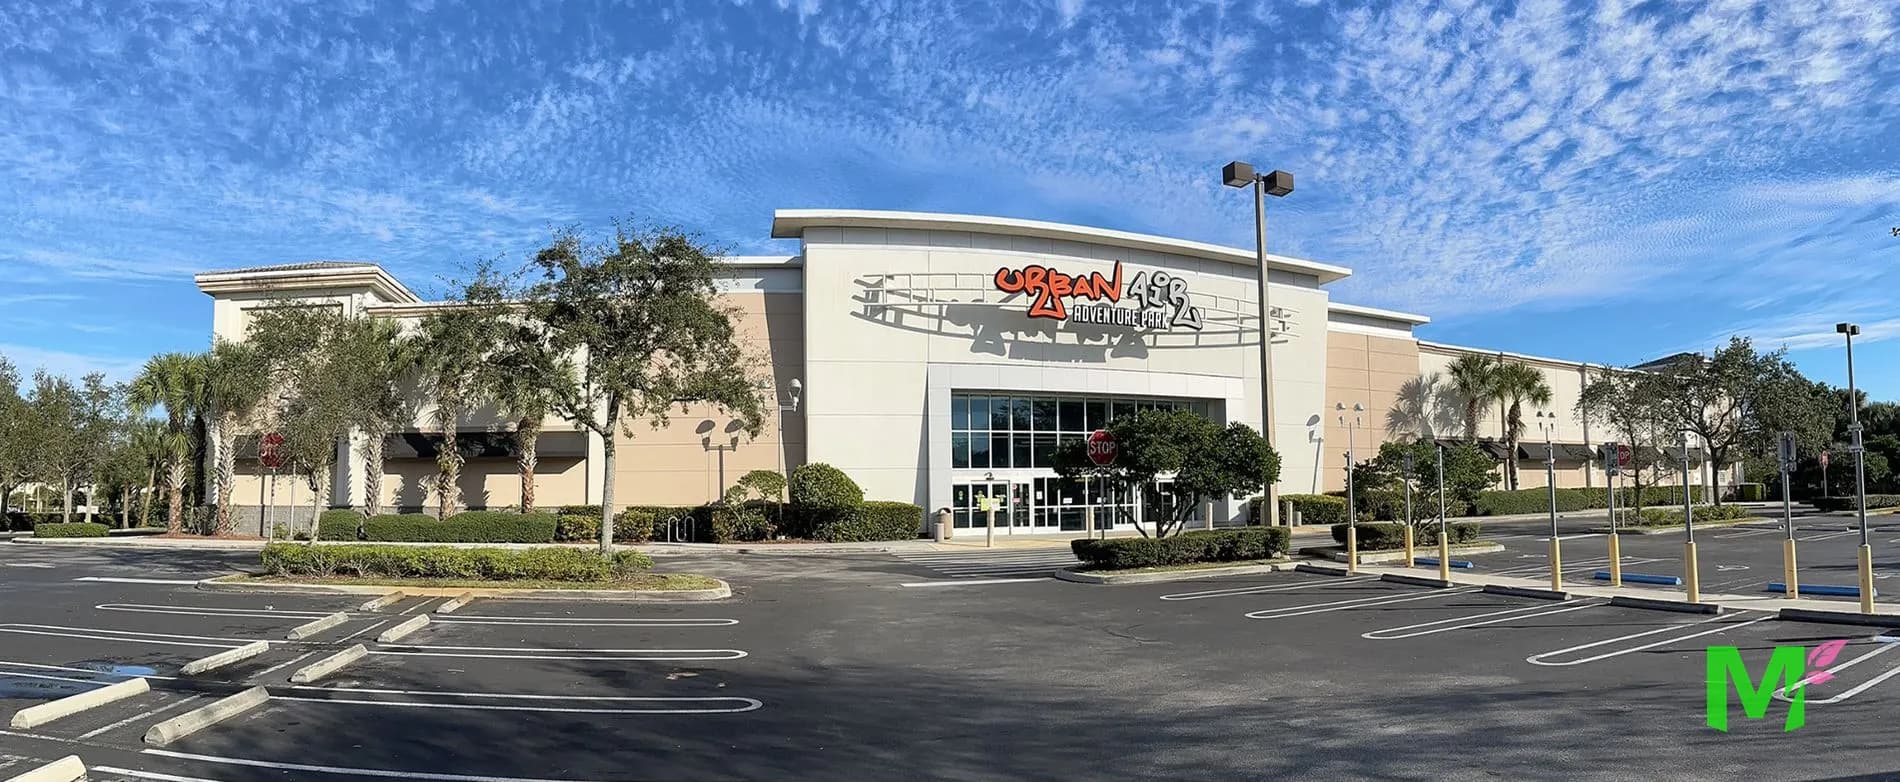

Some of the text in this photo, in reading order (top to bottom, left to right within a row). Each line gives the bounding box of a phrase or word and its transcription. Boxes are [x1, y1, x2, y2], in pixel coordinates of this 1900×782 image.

[995, 260, 1122, 319] URBAN
[1073, 306, 1170, 330] ADVENTURE PARK
[1090, 441, 1115, 454] STOP
